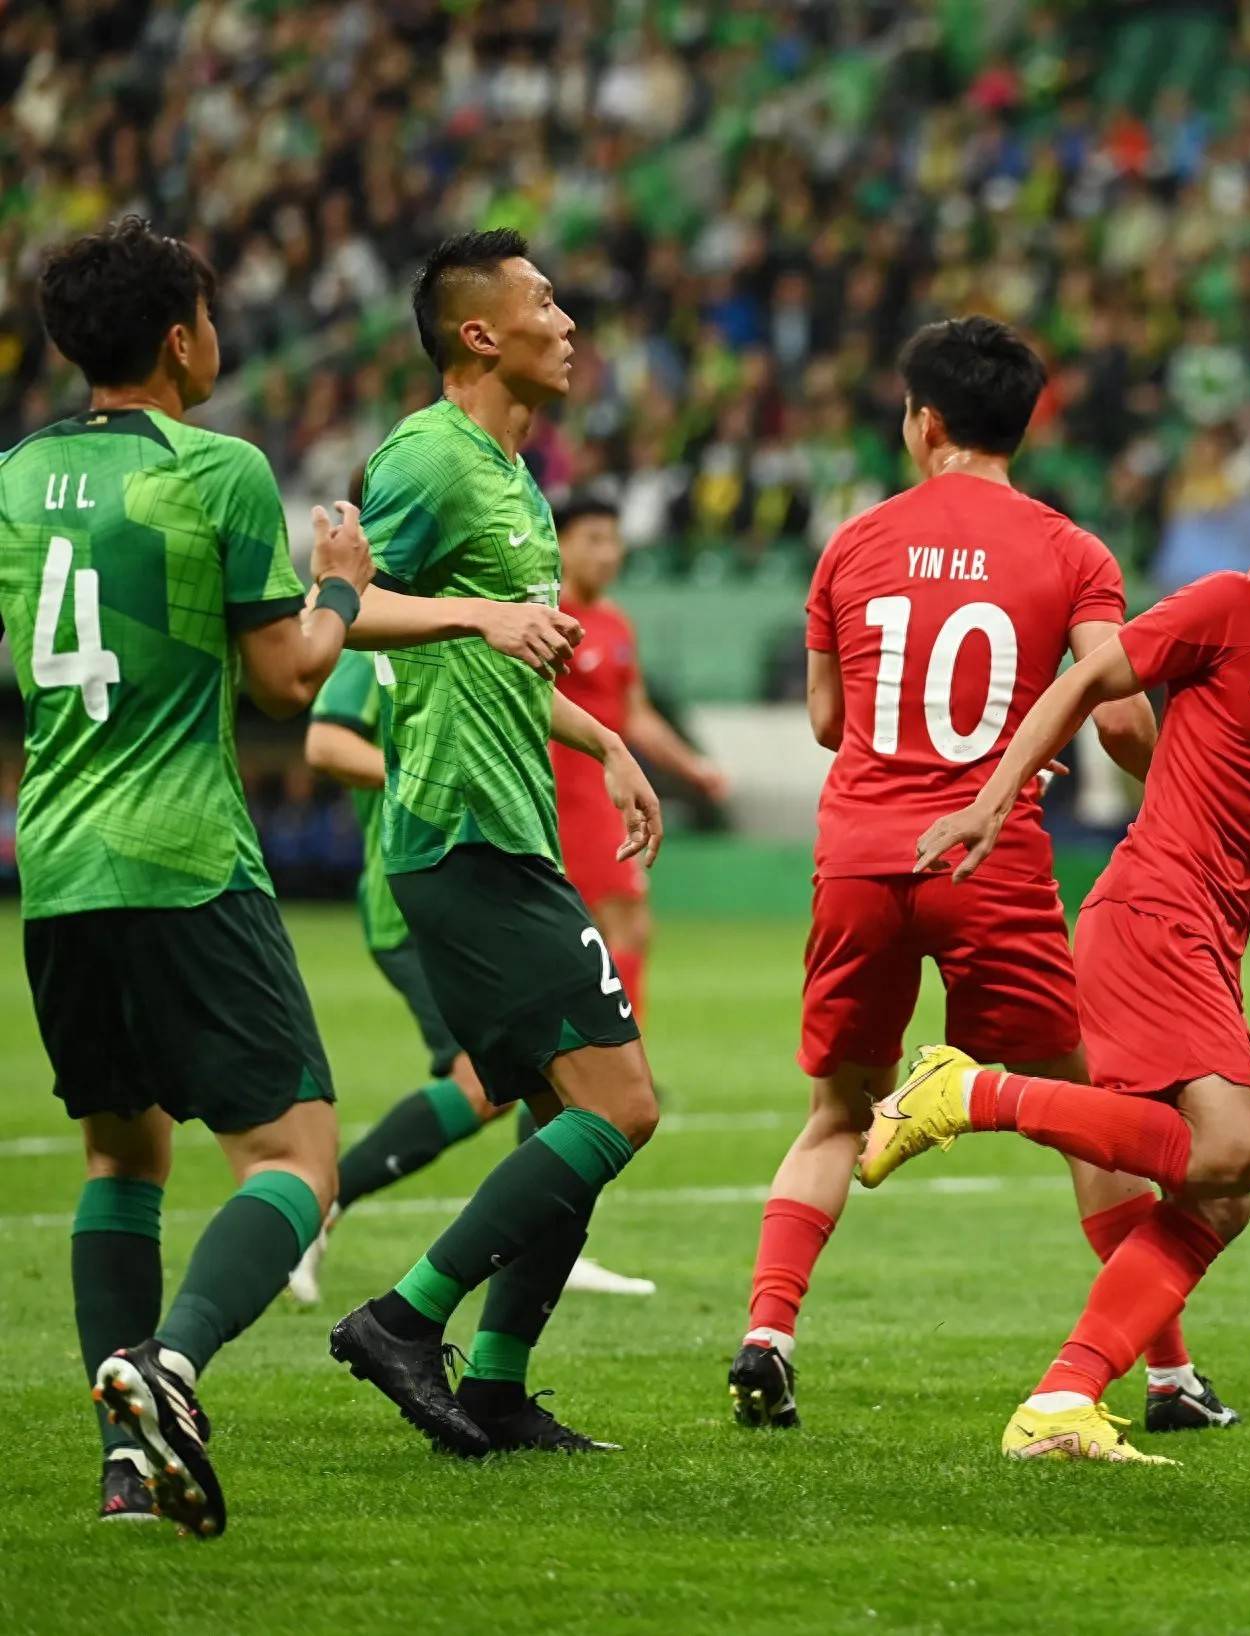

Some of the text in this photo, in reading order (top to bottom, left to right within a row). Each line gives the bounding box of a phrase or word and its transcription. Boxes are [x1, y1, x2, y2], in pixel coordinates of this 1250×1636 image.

[45, 473, 96, 510] LI L.
[907, 546, 989, 581] YIN H.B.
[31, 535, 121, 722] 4
[865, 595, 1018, 763] 10
[580, 926, 622, 995] 2
